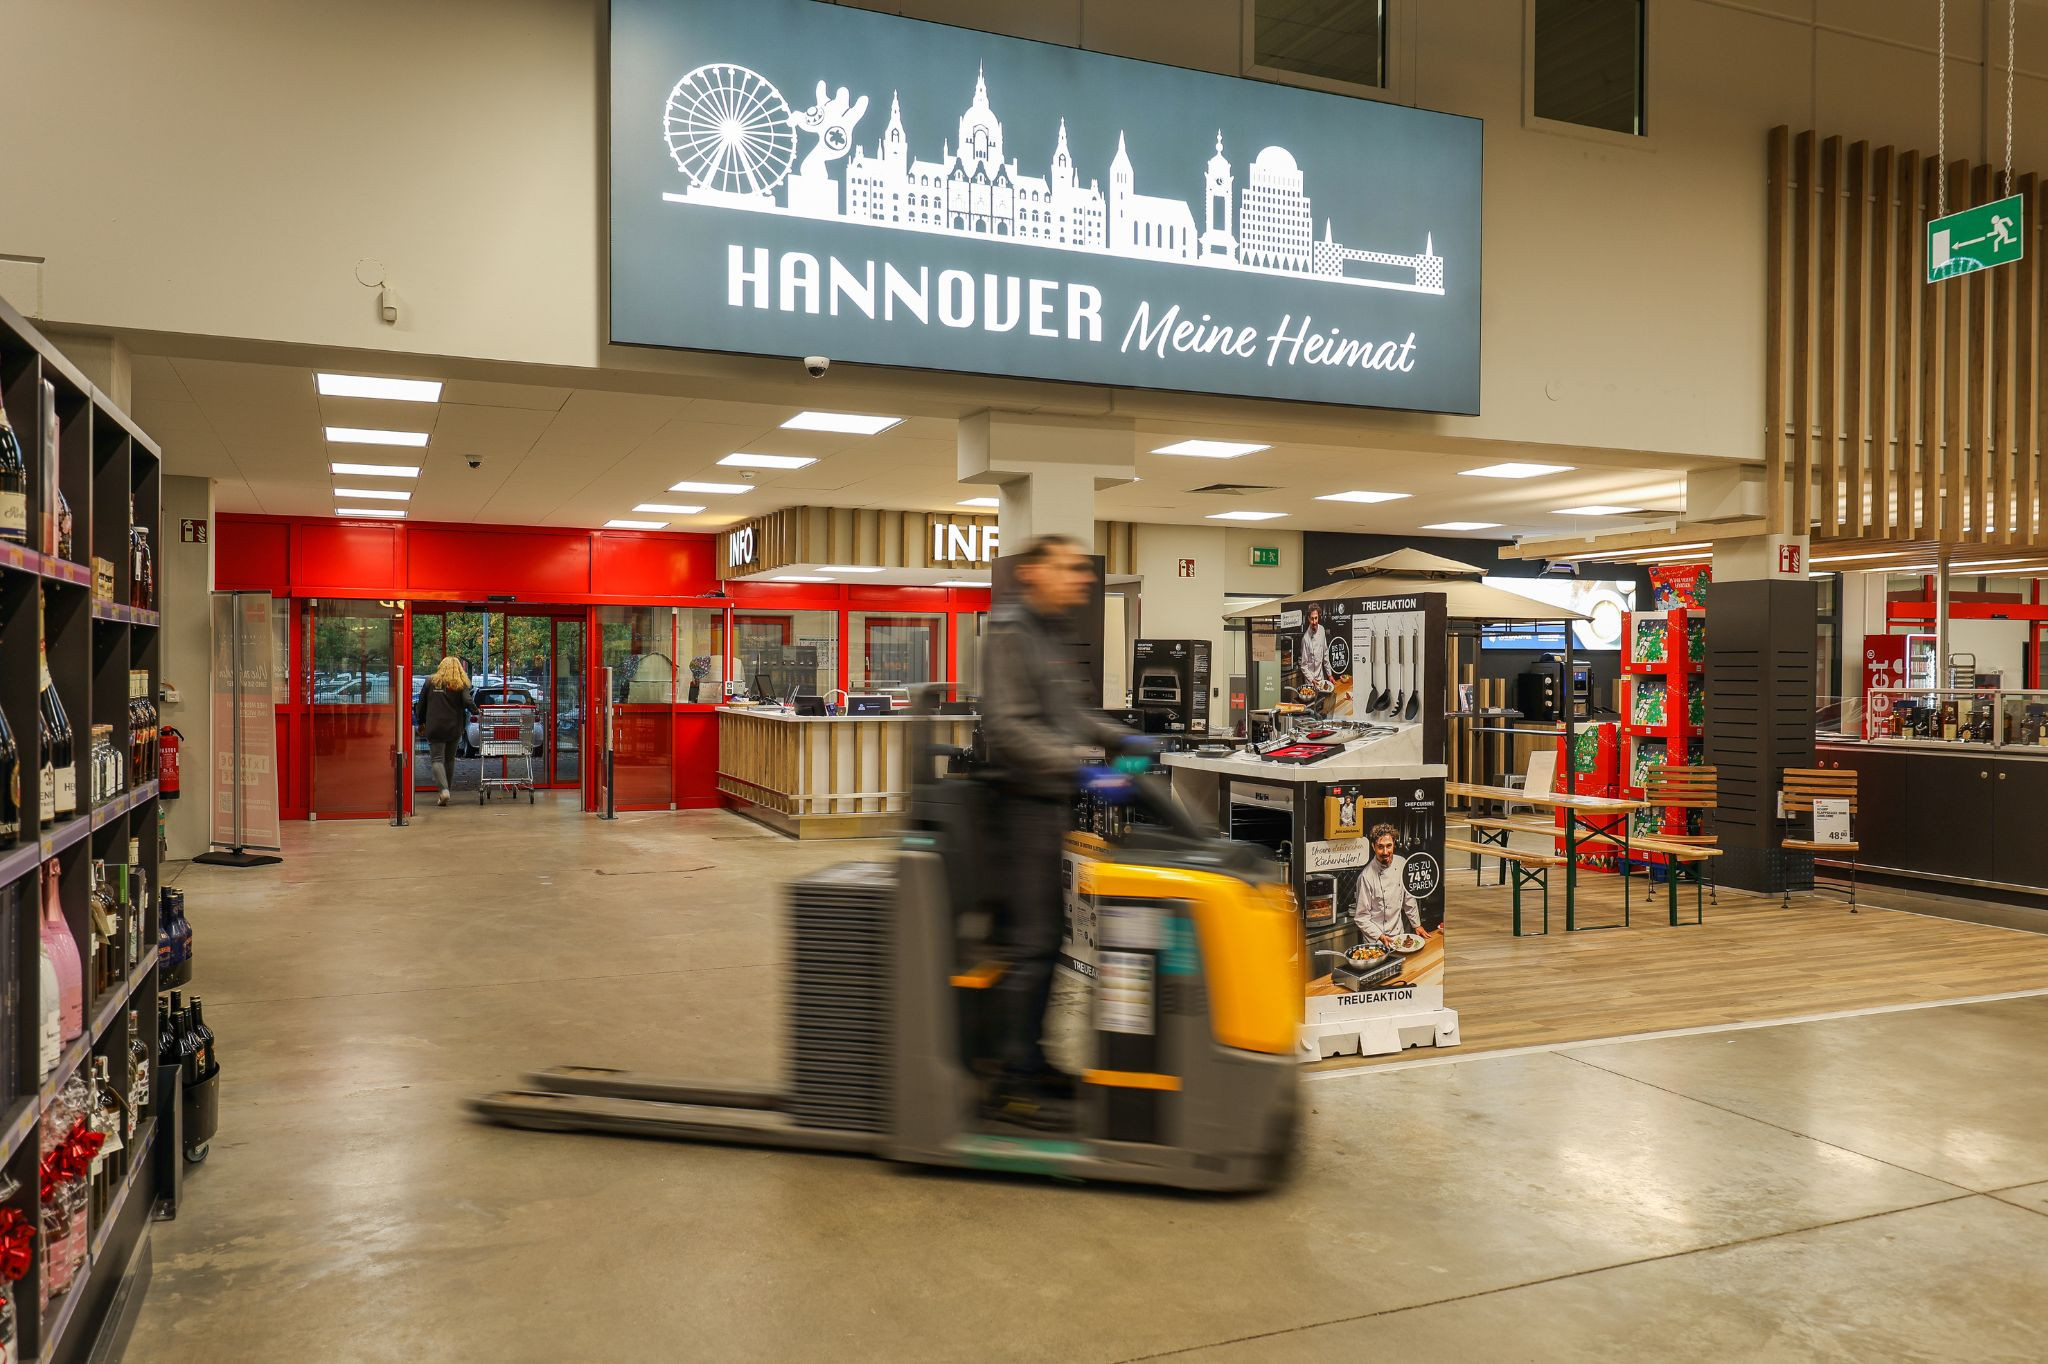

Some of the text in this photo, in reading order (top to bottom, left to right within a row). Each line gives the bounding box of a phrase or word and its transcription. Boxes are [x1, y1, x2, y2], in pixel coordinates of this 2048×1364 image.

[727, 244, 1103, 343] HANNOVER
[1121, 301, 1417, 372] Meine Heimat
[729, 526, 754, 568] INFO
[934, 523, 1000, 563] INF
[1361, 598, 1417, 612] TREUEAKTION
[1408, 861, 1432, 873] BIS ZU
[1408, 880, 1434, 892] SPAREN
[1337, 989, 1413, 1007] TREUEAKTION
